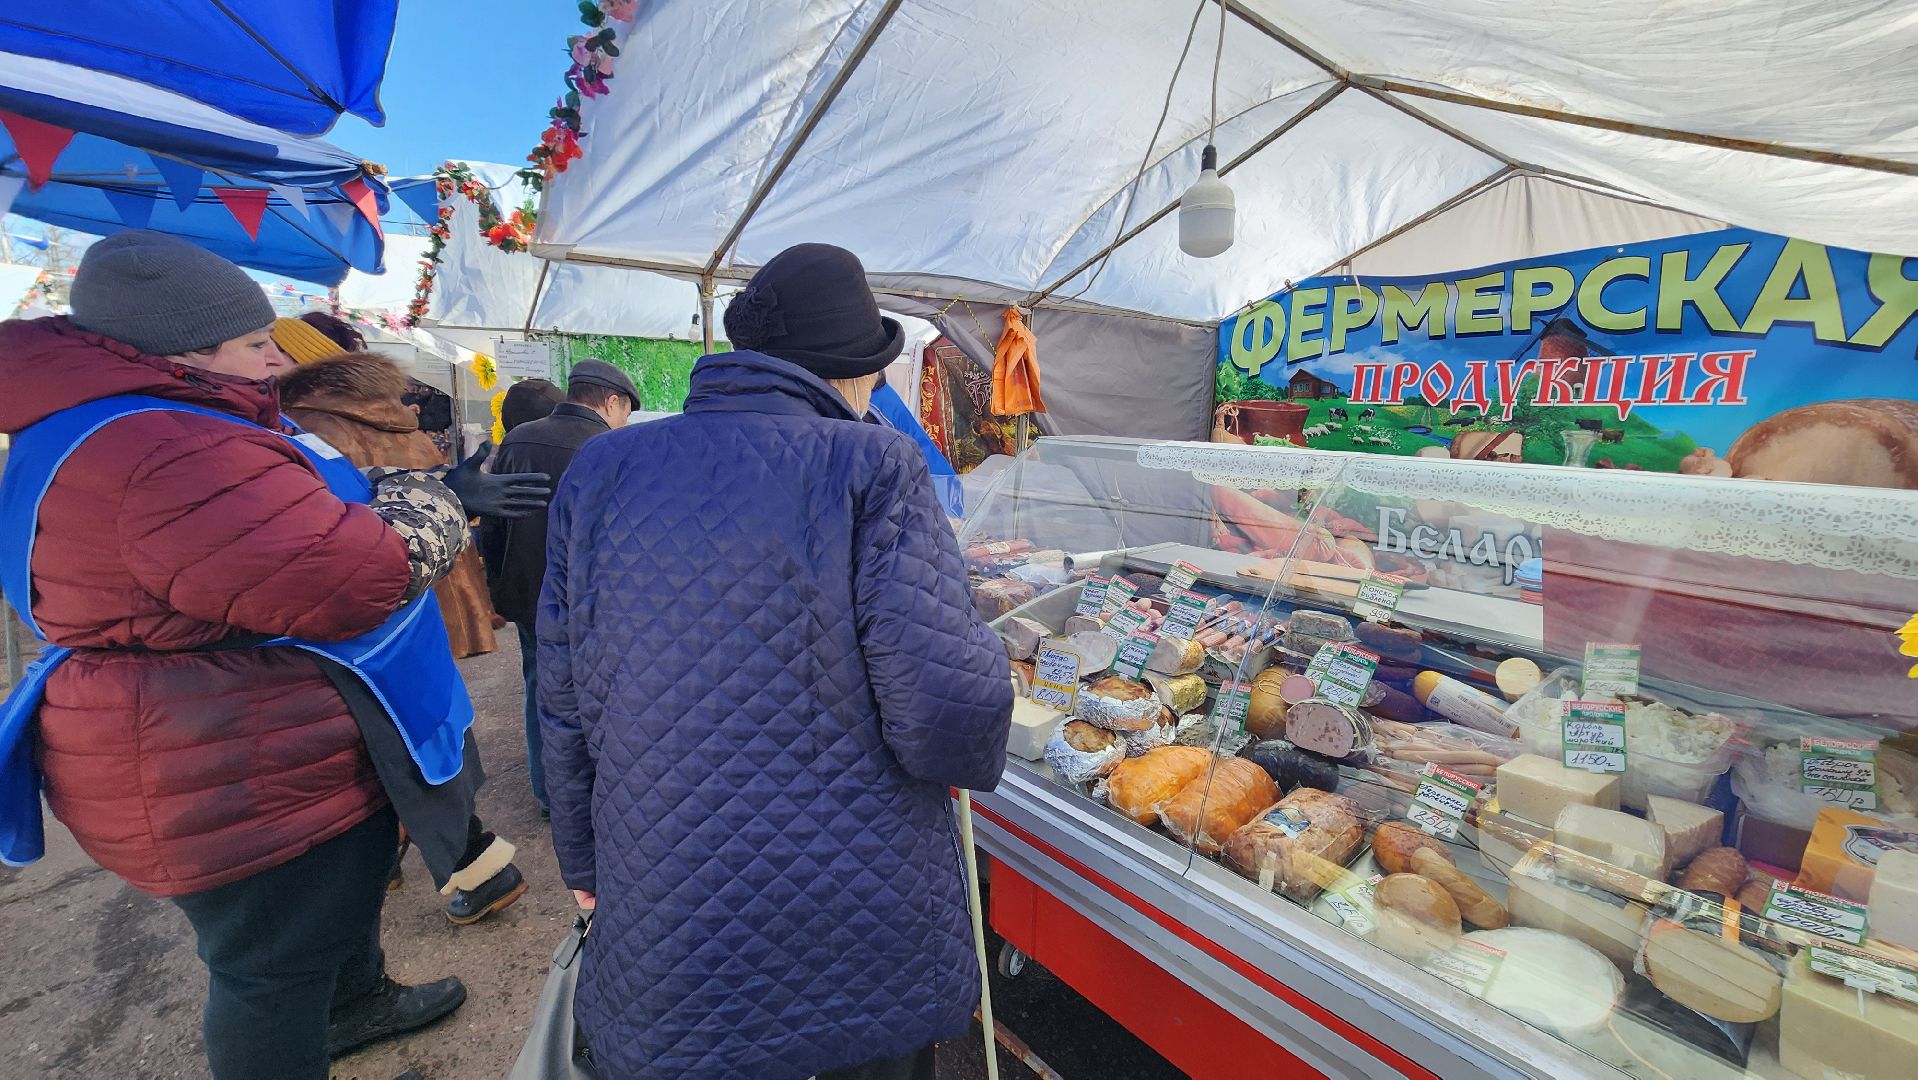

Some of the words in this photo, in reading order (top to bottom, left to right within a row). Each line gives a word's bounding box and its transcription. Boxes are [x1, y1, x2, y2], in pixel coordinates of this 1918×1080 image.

[1229, 236, 1918, 378] ФЕРМЕРСКАЯ
[1347, 349, 1757, 421] ПРОДУКЦИЯ
[1372, 505, 1543, 586] Белар
[1572, 703, 1624, 713] БЕЛОРУССКИЕ
